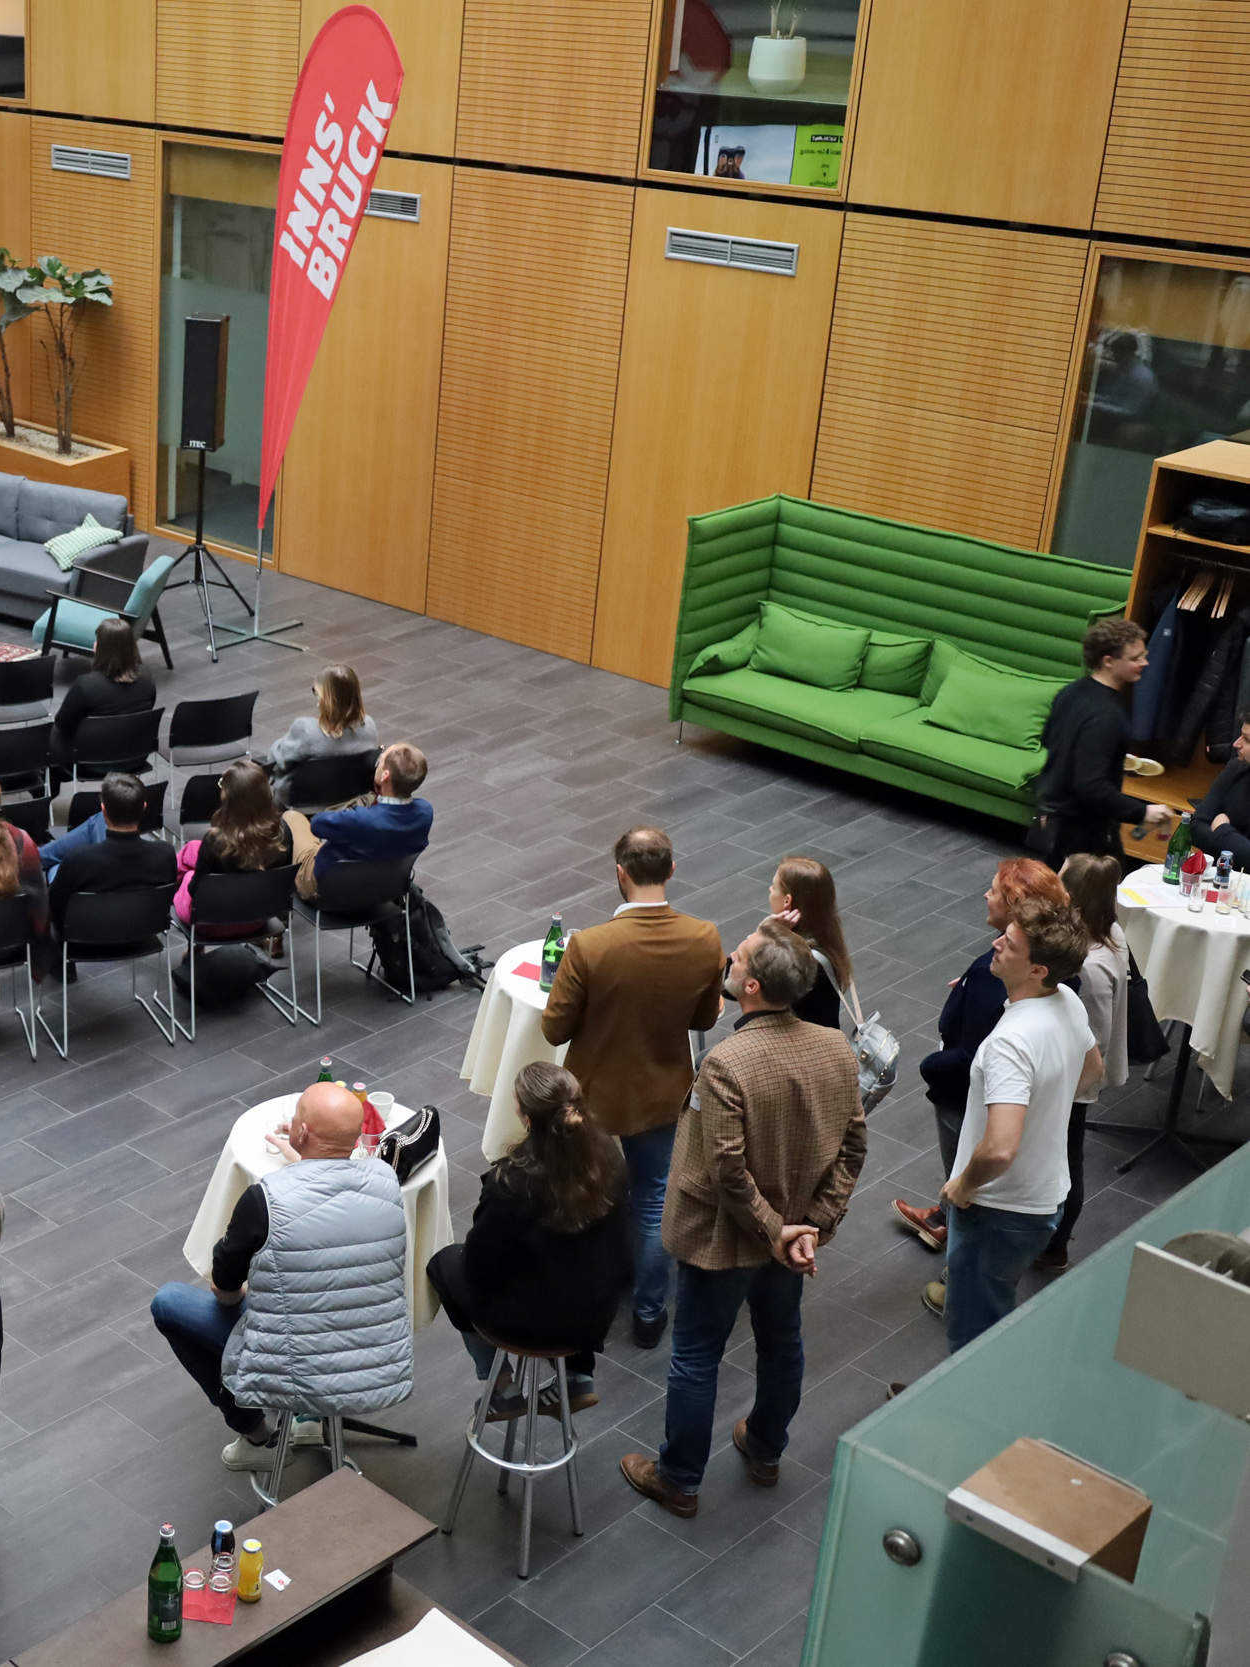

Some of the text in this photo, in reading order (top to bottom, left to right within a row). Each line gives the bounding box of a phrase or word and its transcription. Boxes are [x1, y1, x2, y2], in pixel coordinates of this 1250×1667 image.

[279, 91, 344, 269] INNS'
[306, 79, 394, 300] BRUCK
[190, 440, 207, 448] ITEC
